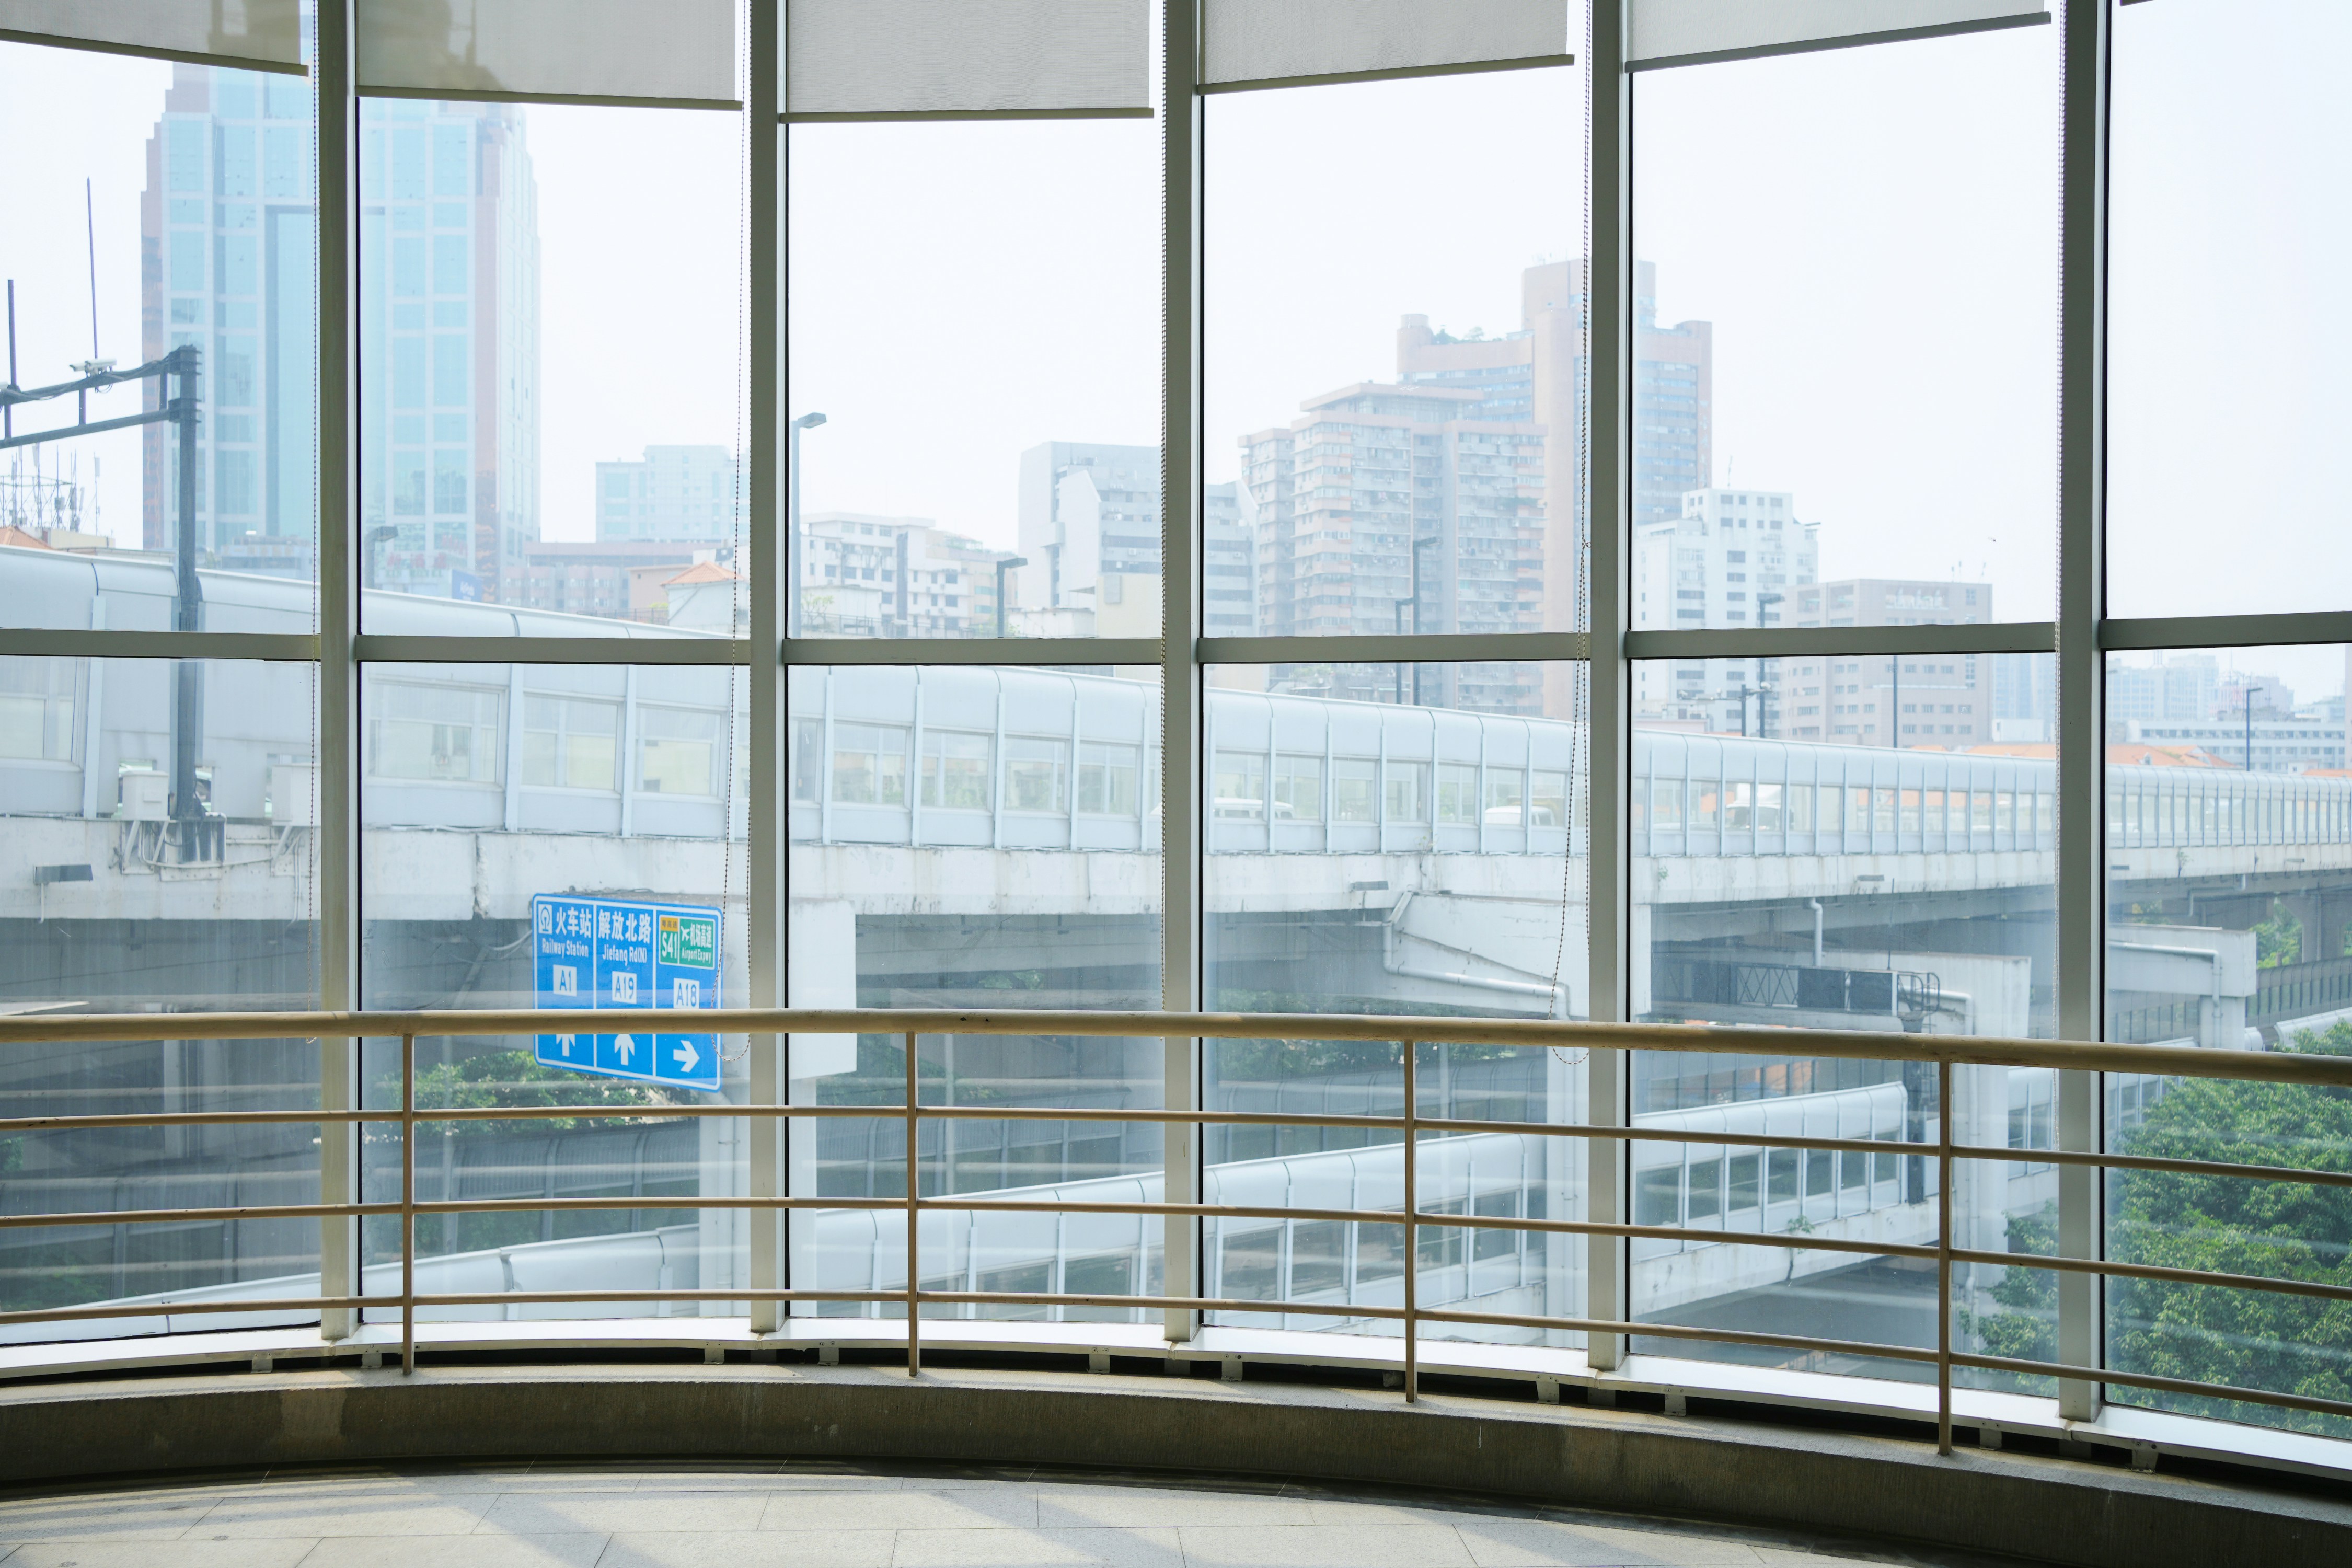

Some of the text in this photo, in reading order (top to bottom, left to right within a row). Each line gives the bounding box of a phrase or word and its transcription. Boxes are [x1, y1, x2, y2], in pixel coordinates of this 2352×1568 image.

[556, 906, 592, 938] 火车站
[598, 908, 651, 944] 解放北路
[662, 931, 678, 959] S41
[690, 922, 712, 948] 机场高速
[542, 938, 589, 959] Railway Station
[602, 943, 647, 966] Jiefang Rd(N)
[681, 947, 711, 964] Airport Expwy
[559, 969, 571, 992] A1
[615, 975, 635, 1000] A19
[676, 982, 697, 1007] A18
